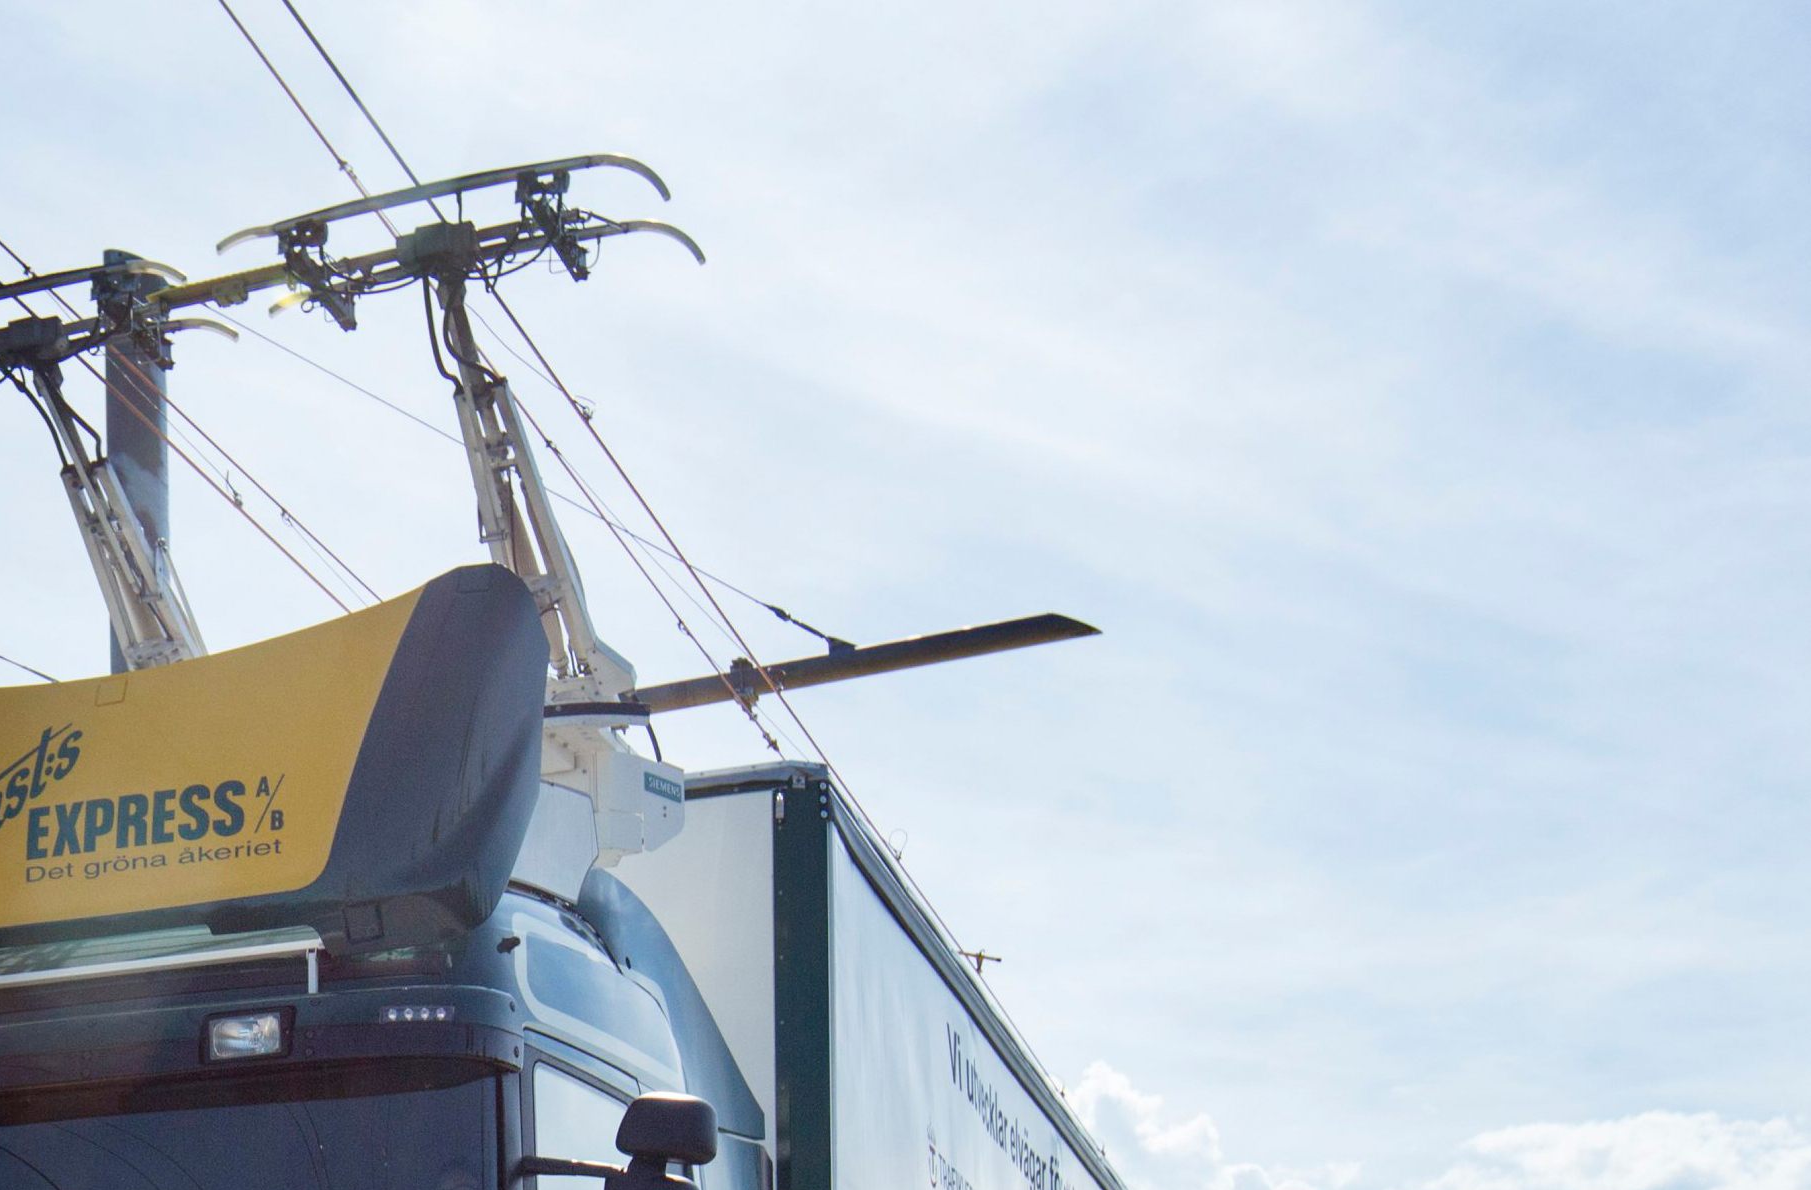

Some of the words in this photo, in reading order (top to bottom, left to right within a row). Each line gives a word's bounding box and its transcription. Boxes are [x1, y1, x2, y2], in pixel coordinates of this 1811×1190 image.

[648, 776, 681, 798] SIEMENS
[25, 780, 246, 860] EXPRESS
[26, 864, 73, 883] Det
[84, 851, 167, 880] gröna
[178, 839, 283, 865] åkeriet
[946, 1022, 963, 1092] Vi
[966, 1057, 1008, 1153] utvecklar
